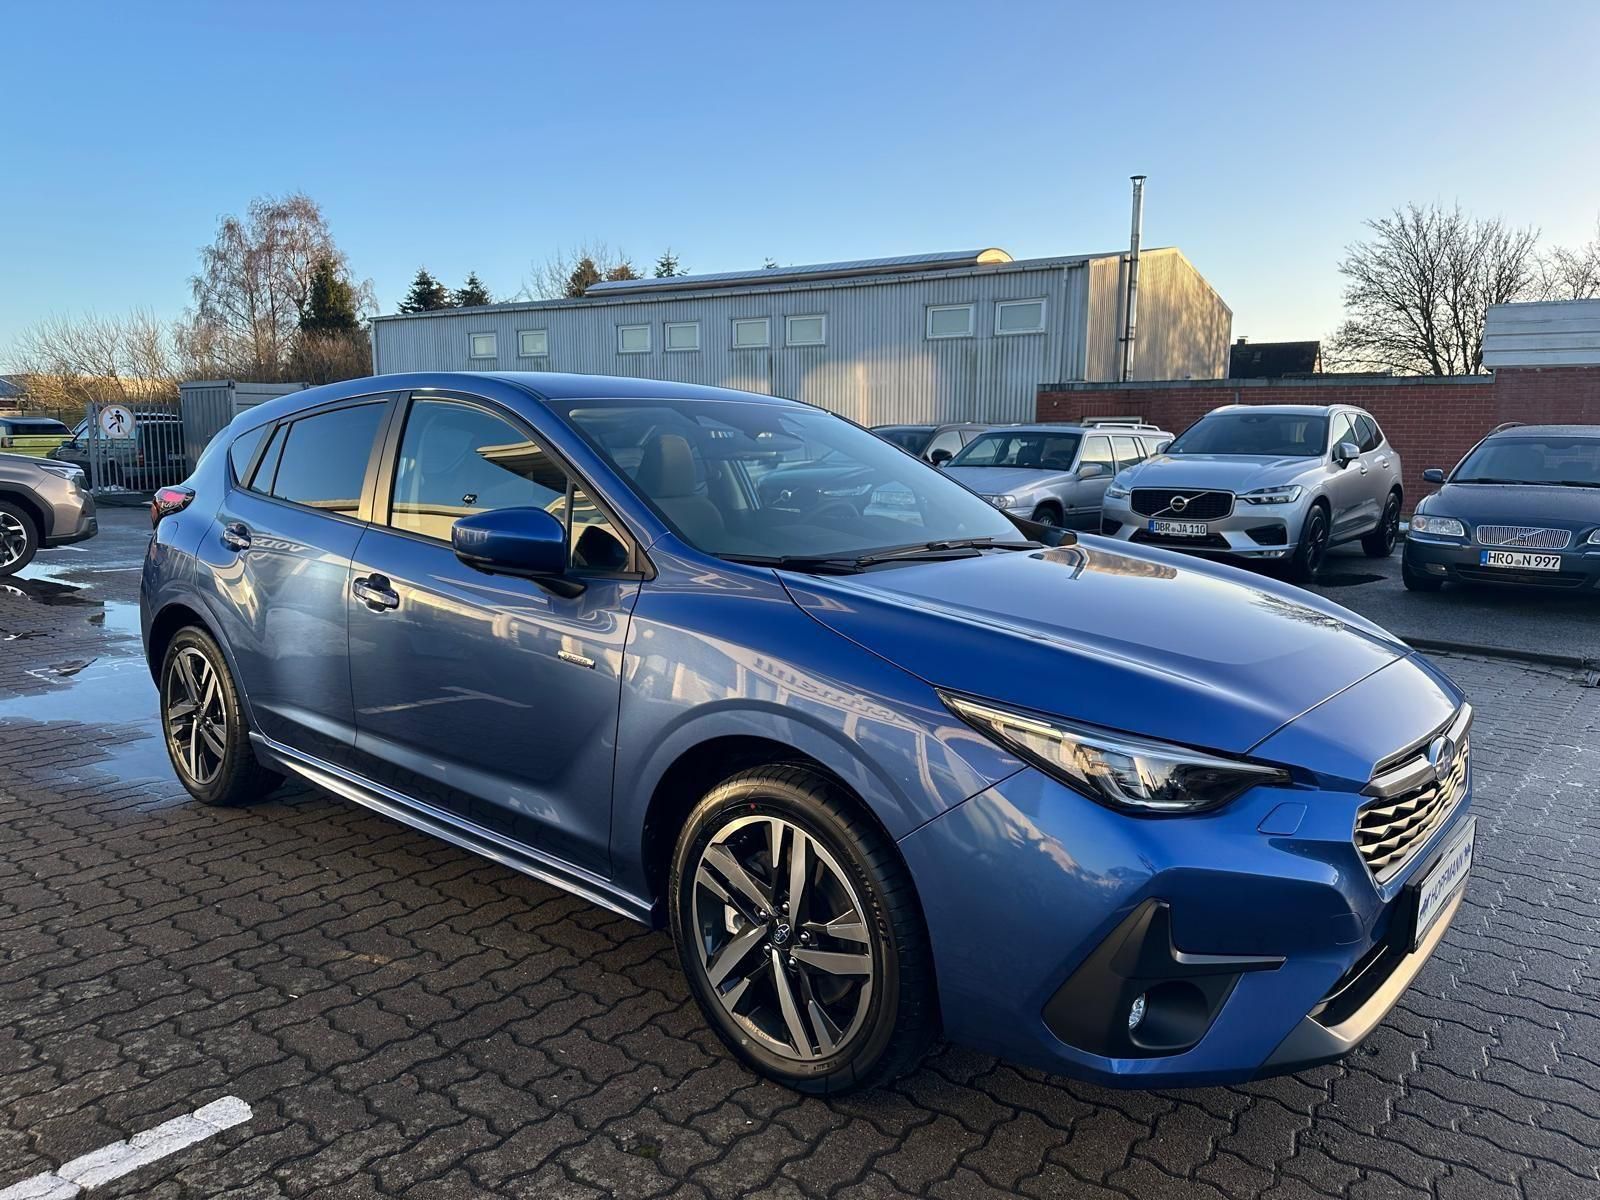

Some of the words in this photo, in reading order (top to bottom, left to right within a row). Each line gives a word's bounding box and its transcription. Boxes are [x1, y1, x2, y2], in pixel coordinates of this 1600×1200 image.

[1155, 522, 1170, 532] DBR
[1177, 524, 1187, 533] JA
[1189, 524, 1206, 534] 110
[1488, 552, 1514, 565] HRO
[1522, 555, 1531, 566] N
[1534, 556, 1560, 568] 997
